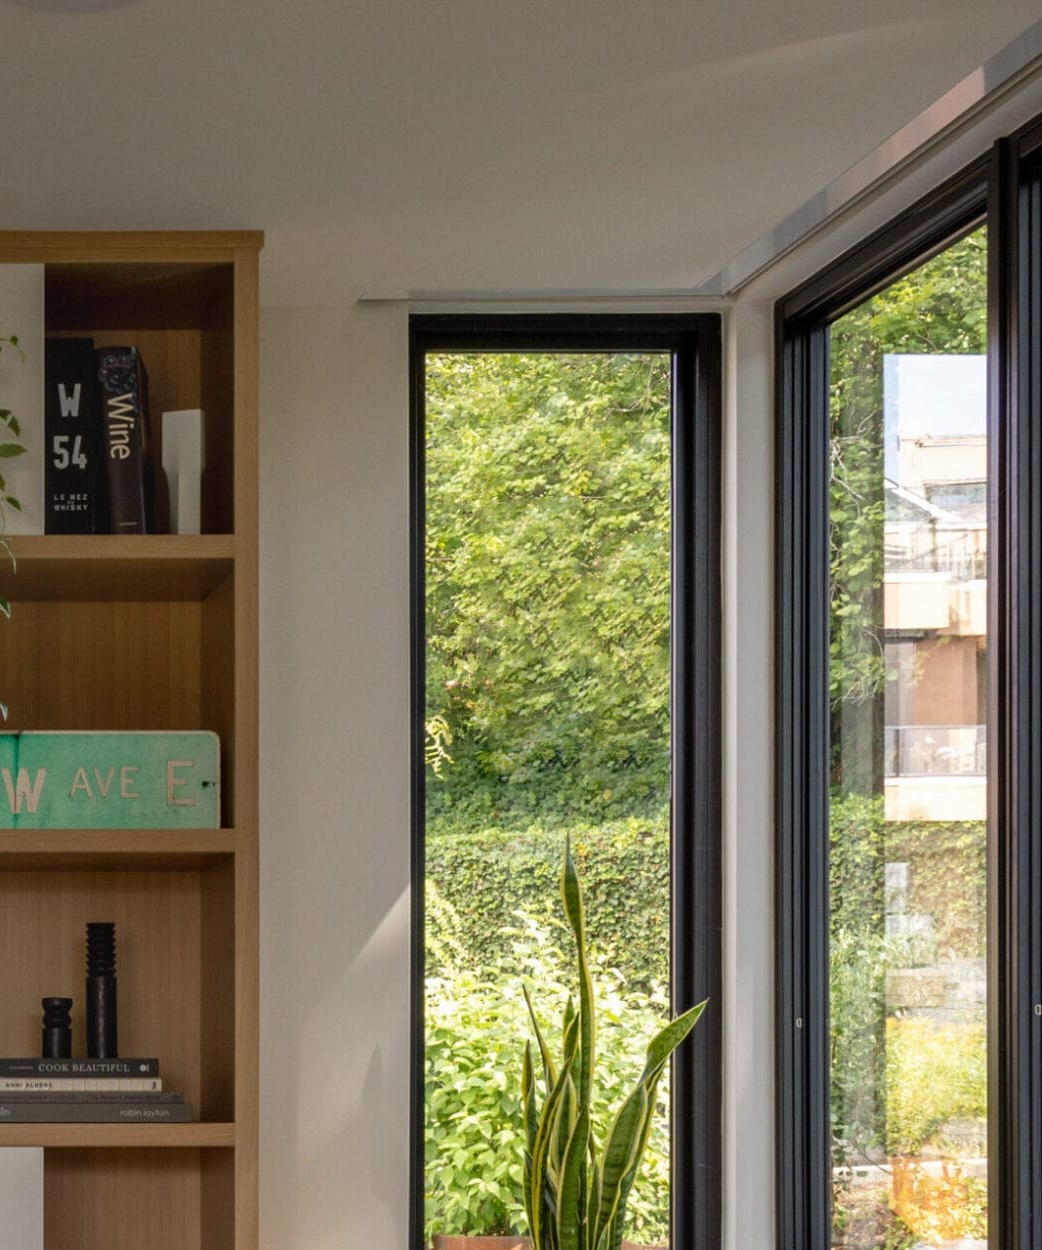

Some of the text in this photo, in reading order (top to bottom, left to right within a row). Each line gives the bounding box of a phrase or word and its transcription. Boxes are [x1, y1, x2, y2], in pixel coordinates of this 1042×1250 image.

[57, 382, 82, 418] W
[107, 392, 135, 460] Wine
[52, 435, 88, 470] 54
[68, 766, 142, 799] AVE
[166, 760, 197, 807] E
[38, 1063, 70, 1073] COOK
[72, 1063, 131, 1073] BEAUTIFUL
[119, 1108, 170, 1118] robin layton
